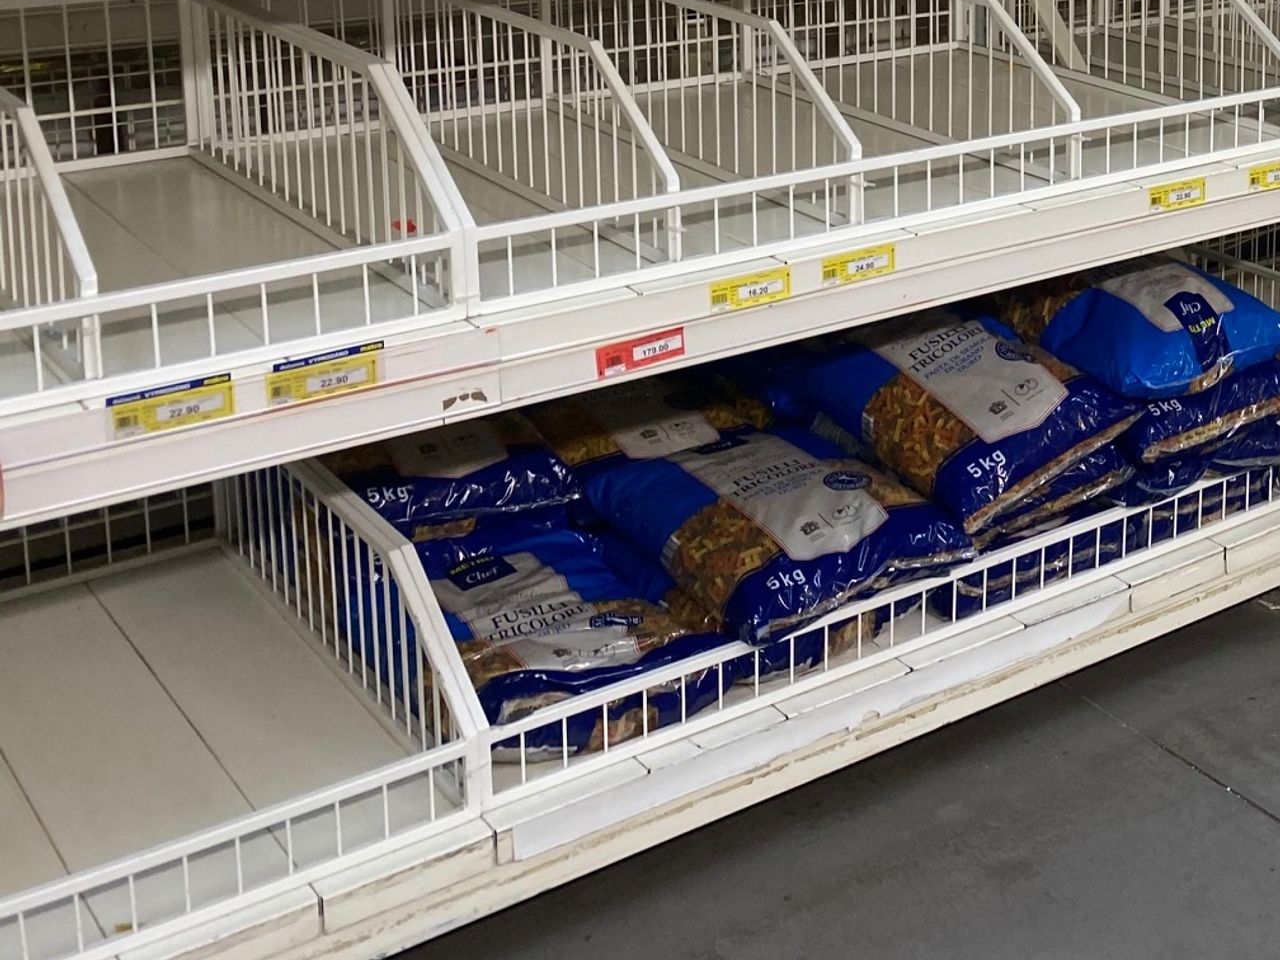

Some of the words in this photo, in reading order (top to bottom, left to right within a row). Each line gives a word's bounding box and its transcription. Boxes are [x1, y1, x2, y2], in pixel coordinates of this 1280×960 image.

[855, 261, 874, 272] 24.90
[748, 285, 769, 297] 16.20
[643, 342, 669, 357] 179.00
[320, 375, 348, 388] 22.90
[169, 404, 200, 419] 22.90
[1149, 402, 1161, 417] 5
[1160, 398, 1182, 414] kg
[967, 463, 982, 478] 5
[983, 450, 1007, 471] kg
[366, 487, 380, 503] 5
[382, 486, 410, 503] kg
[465, 566, 499, 584] Chef
[766, 576, 780, 590] 5
[779, 569, 806, 587] kg
[490, 601, 571, 630] FUSILLI
